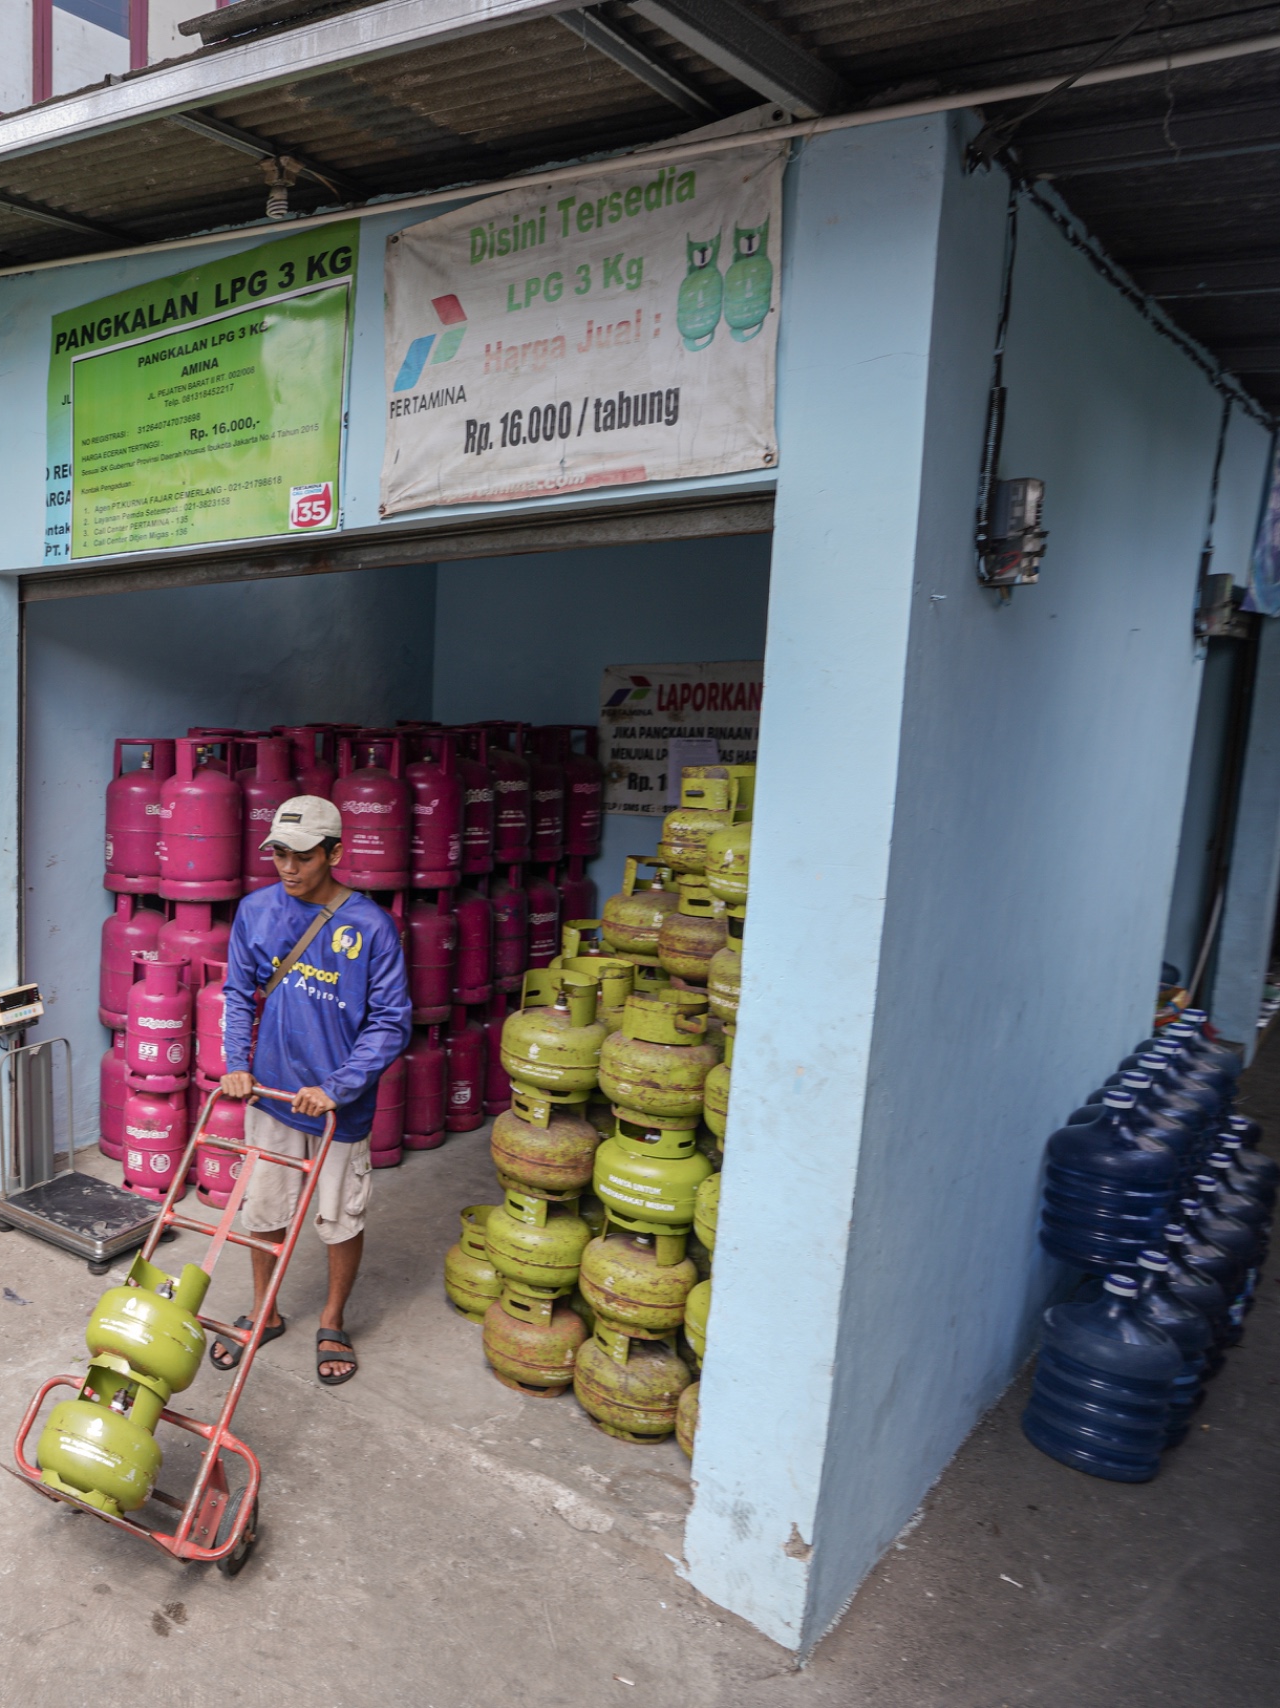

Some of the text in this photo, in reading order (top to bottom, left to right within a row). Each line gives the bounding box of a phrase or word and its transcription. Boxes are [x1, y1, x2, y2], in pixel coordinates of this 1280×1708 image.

[469, 166, 696, 266] Disini Tersedia
[507, 252, 644, 313] LPG 3 Kg
[55, 246, 353, 354] PANGKALAN LPG 3 KG
[137, 338, 208, 367] PANGKALAN
[211, 330, 235, 347] LPG
[238, 326, 246, 339] 3
[484, 333, 567, 373] Harga
[577, 309, 642, 354] Jual
[181, 357, 219, 378] AMINA
[157, 384, 187, 398] PEJATEN
[187, 378, 209, 391] BARAT
[390, 385, 467, 419] PERTAMINA
[464, 386, 680, 456] Rp. 16.000 / tabung
[190, 428, 208, 441] Rp.
[232, 435, 258, 448] Jakarta
[277, 427, 300, 438] Tahun
[300, 422, 319, 434] 2015
[82, 452, 102, 463] HARGA
[128, 441, 160, 453] TERTINGGI
[149, 494, 173, 505] FAJAR
[174, 485, 222, 501] CEMERLANG
[291, 500, 327, 523] 135
[130, 518, 170, 531] PERTAMINA
[656, 682, 764, 712] LAPORKAN
[601, 708, 653, 717] PERTAMINA
[612, 726, 751, 740] JIKA PANGKALAN BINAAN
[611, 747, 655, 761] MENJUAL
[656, 748, 668, 761] LP
[719, 749, 734, 763] TAS
[627, 772, 667, 792] Rp. 1
[272, 956, 341, 985] Auaproof
